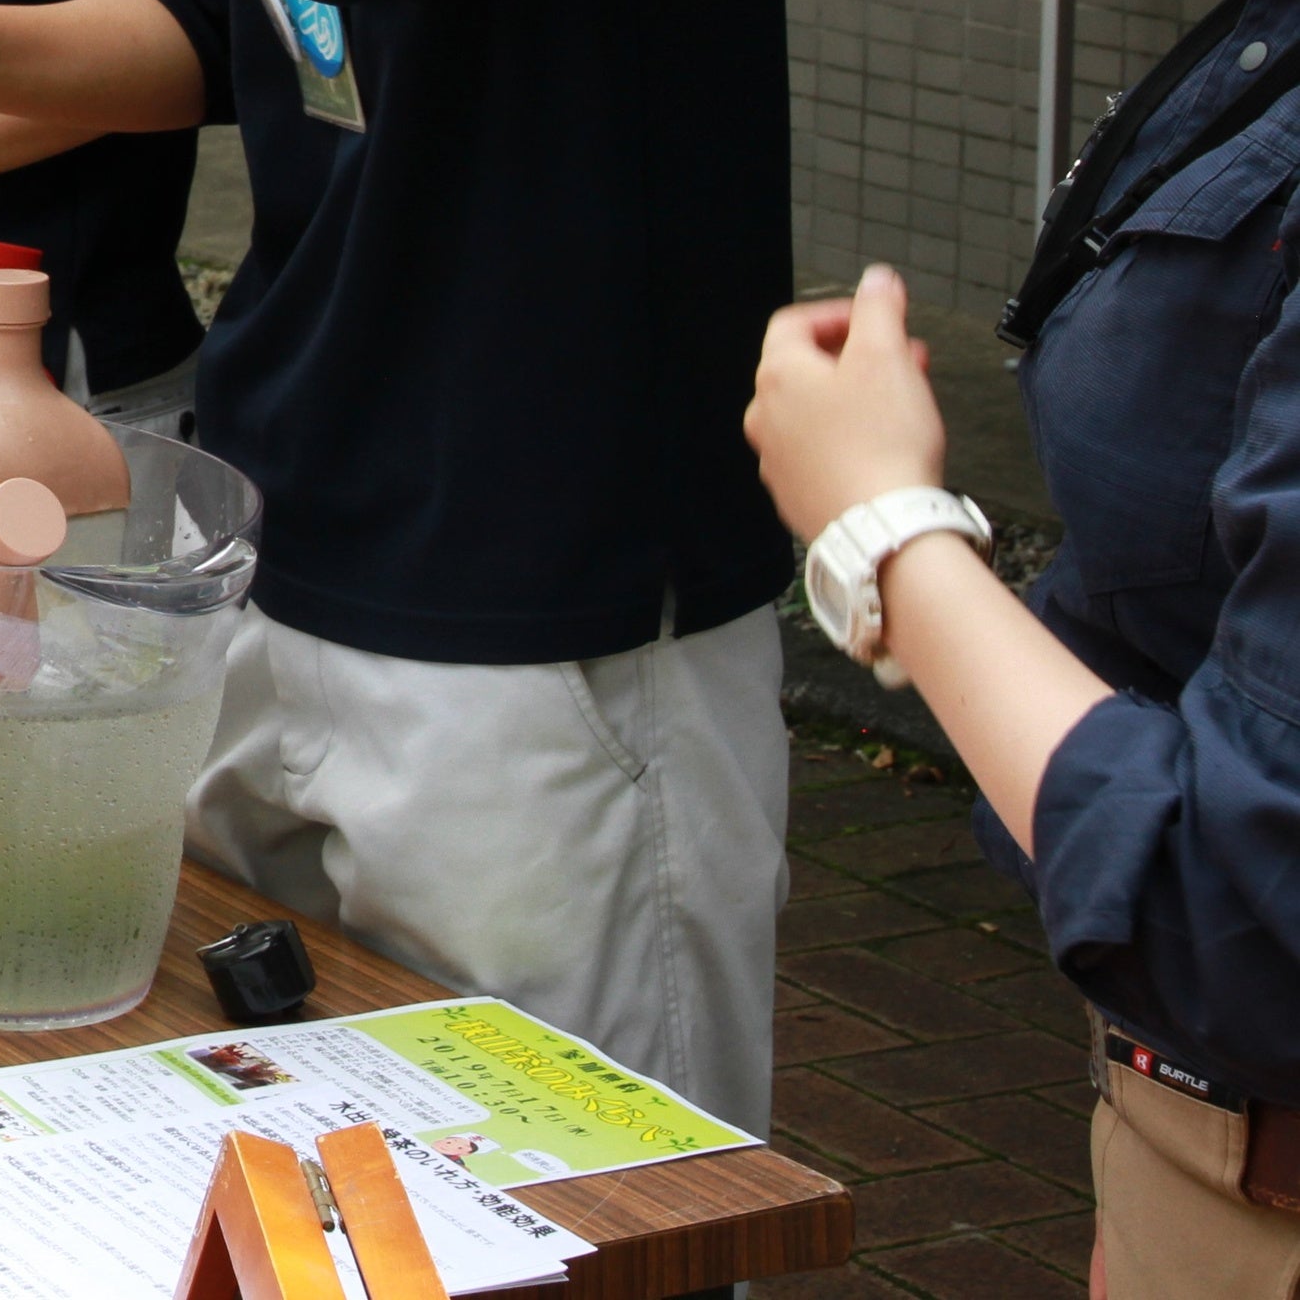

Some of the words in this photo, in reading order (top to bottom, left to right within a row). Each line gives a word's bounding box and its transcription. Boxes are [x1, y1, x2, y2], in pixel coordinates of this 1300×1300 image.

[444, 1018, 675, 1142] 狭山茶のみくらべ
[1159, 1063, 1209, 1092] BURTLE
[330, 1100, 559, 1239] 水出緑茶のいれ方・効能効果
